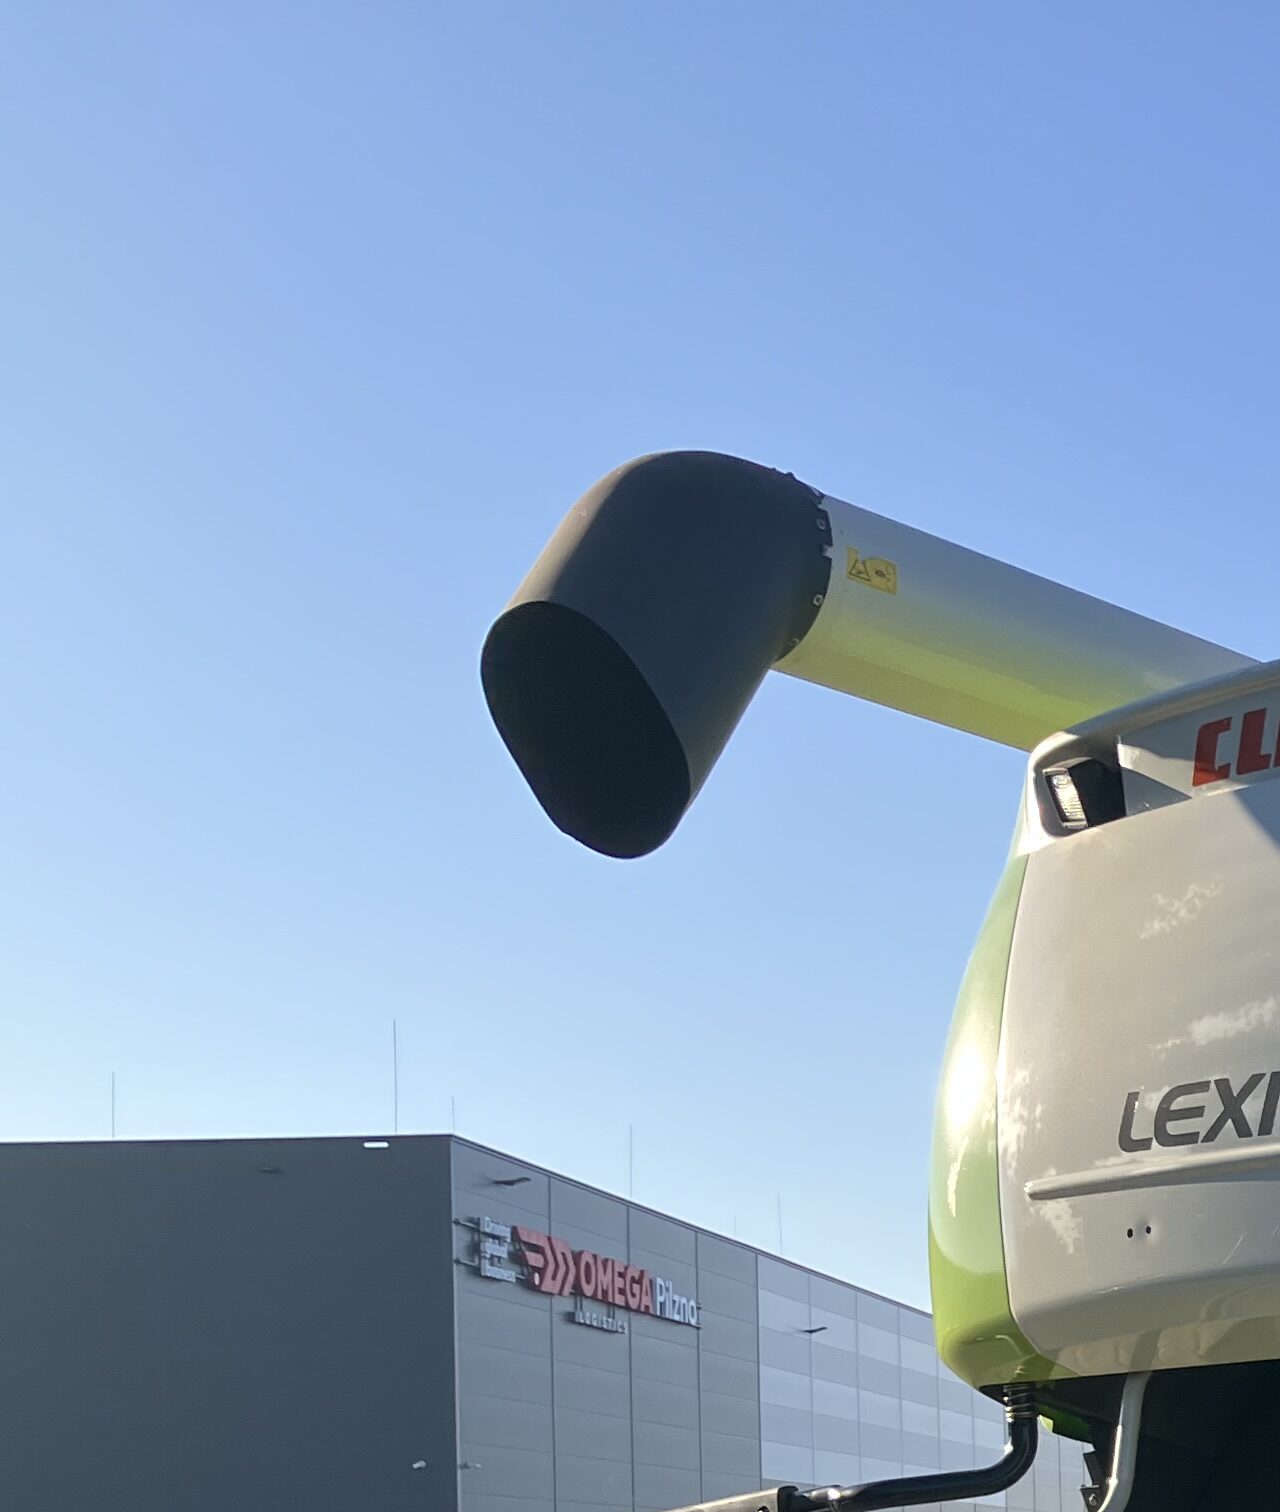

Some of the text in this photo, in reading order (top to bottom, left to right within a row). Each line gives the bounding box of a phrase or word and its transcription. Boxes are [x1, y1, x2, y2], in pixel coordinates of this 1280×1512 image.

[577, 1250, 698, 1326] OMEGA Pilzno
[577, 1310, 629, 1336] LOGISTICS
